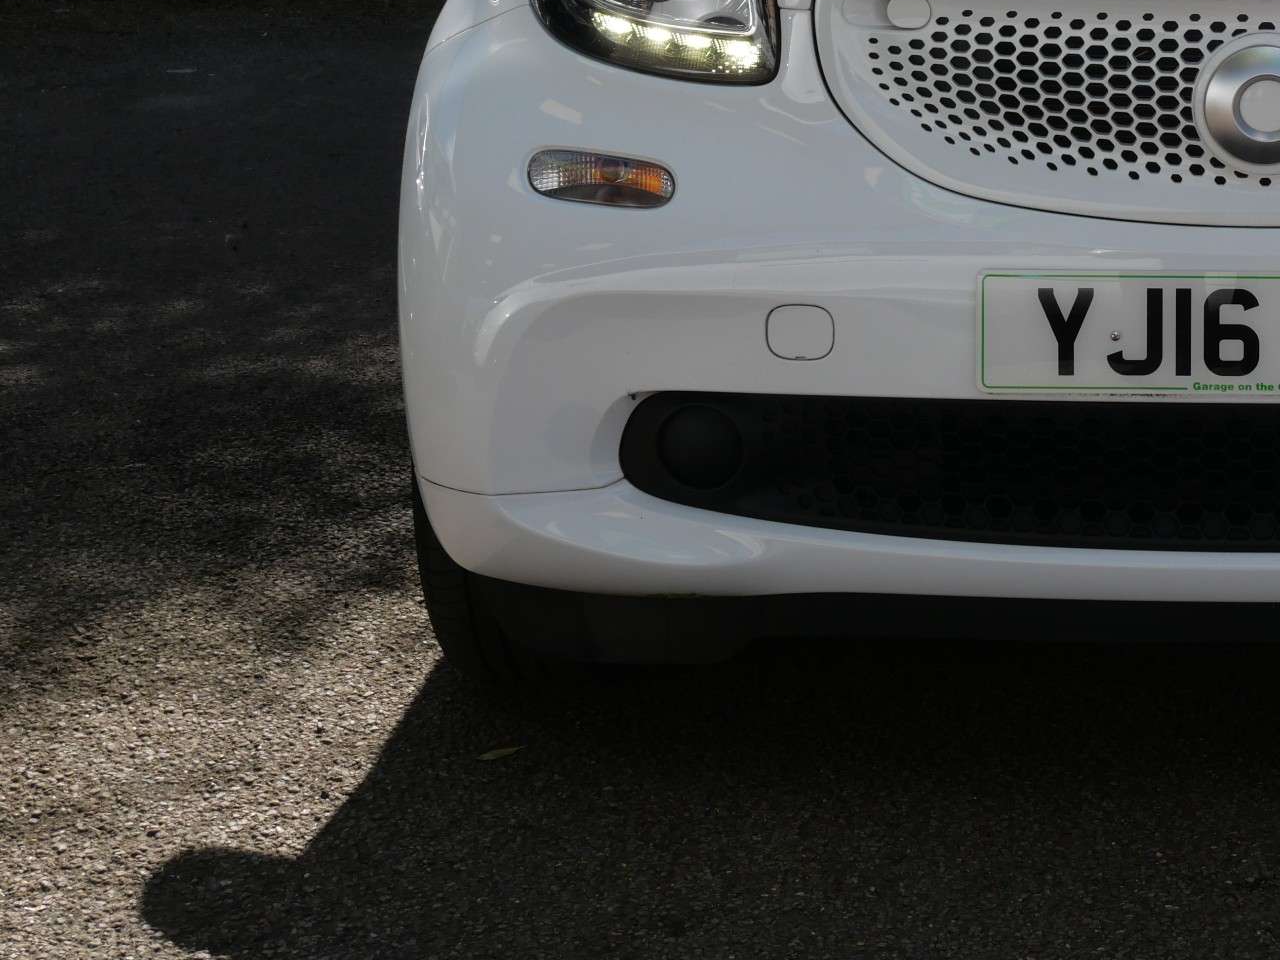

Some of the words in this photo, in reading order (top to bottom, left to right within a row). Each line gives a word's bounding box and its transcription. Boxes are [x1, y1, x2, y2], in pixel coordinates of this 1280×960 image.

[1037, 287, 1260, 377] YJ16
[1192, 382, 1235, 393] Garage
[1256, 382, 1275, 392] the
